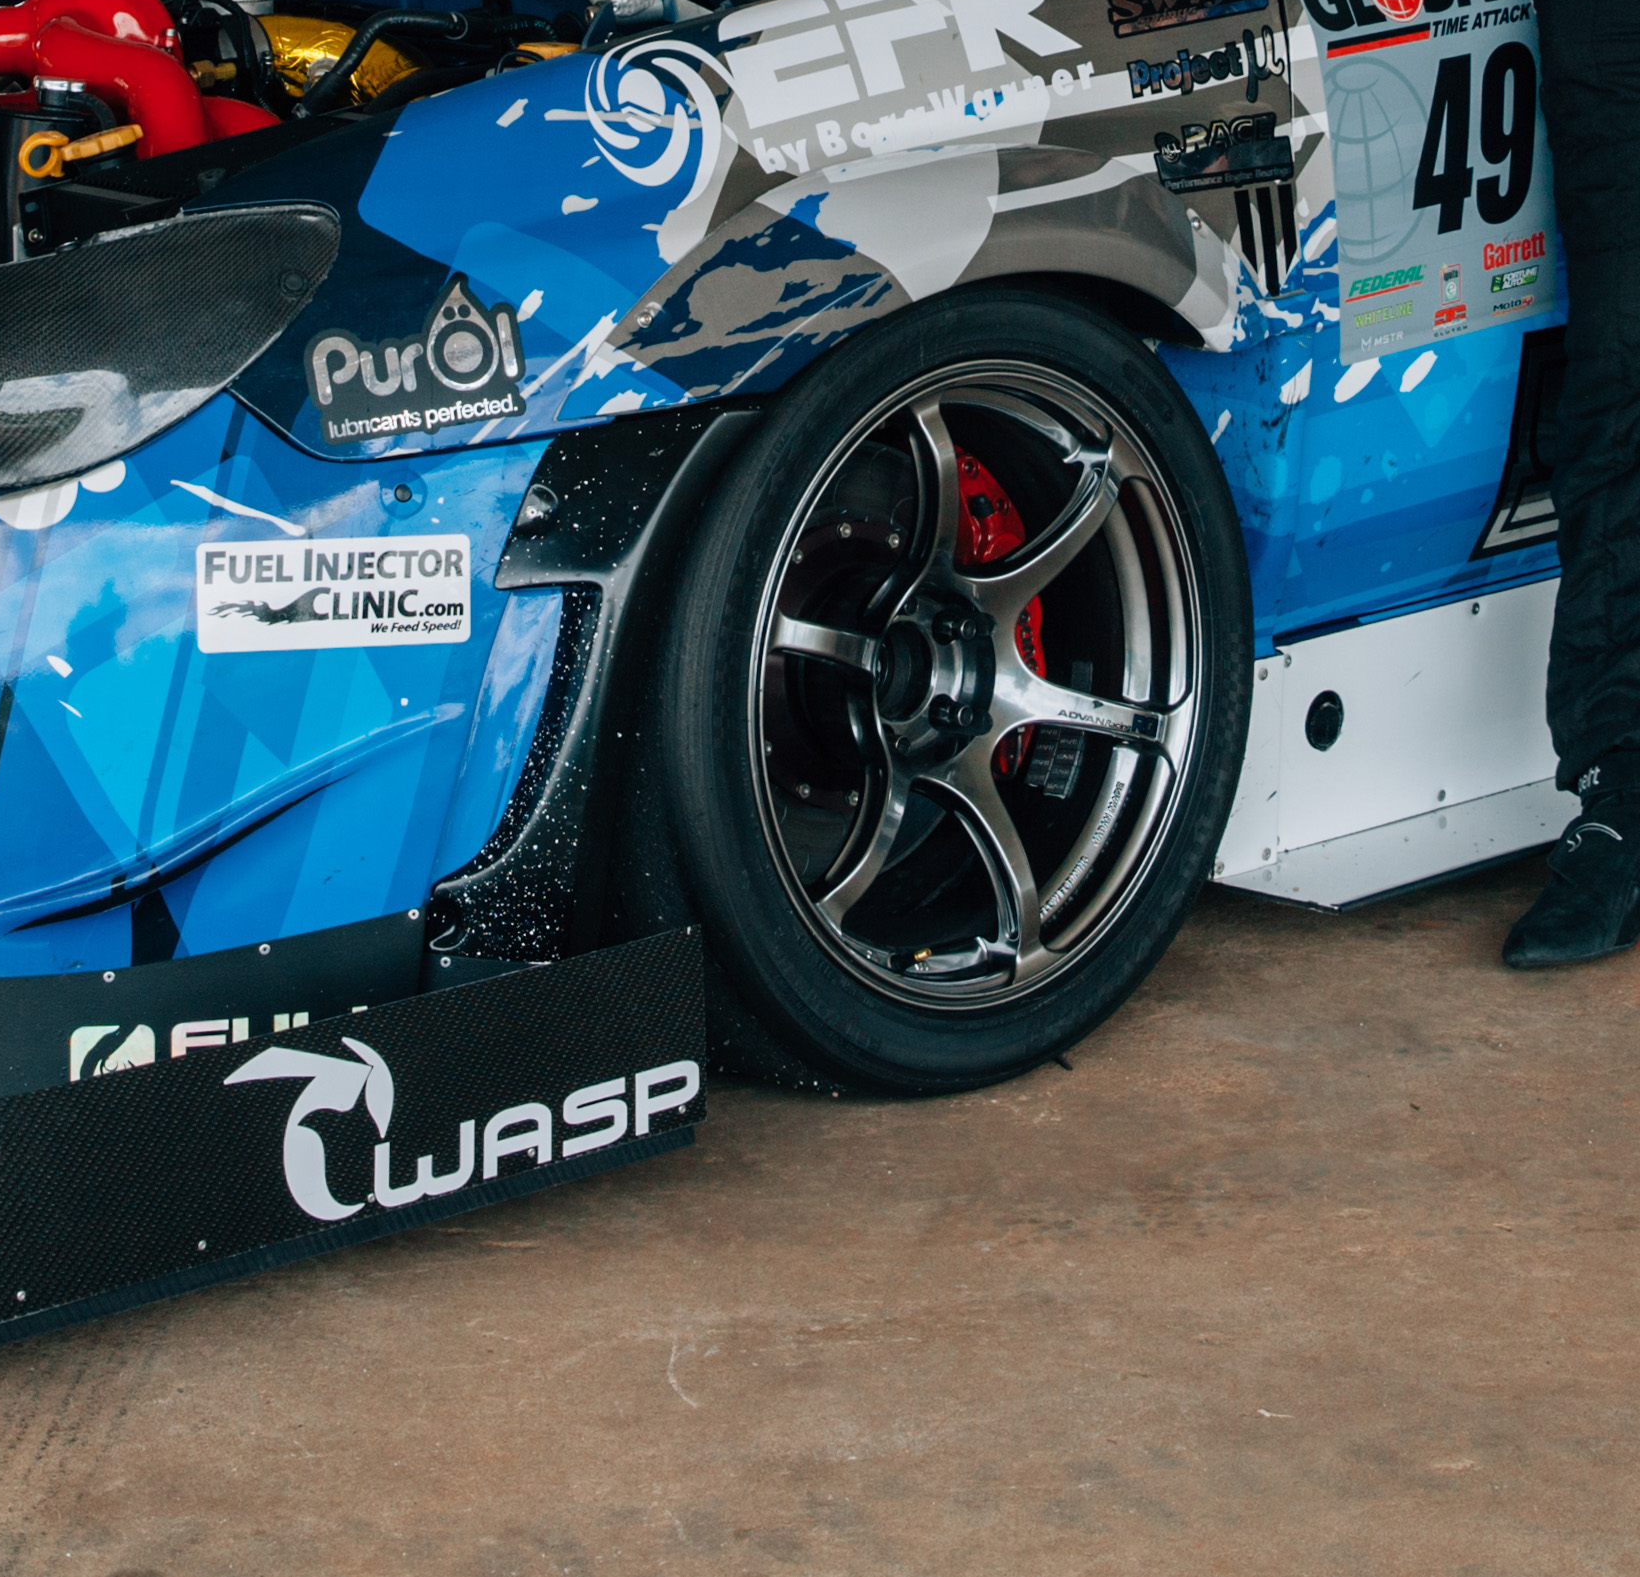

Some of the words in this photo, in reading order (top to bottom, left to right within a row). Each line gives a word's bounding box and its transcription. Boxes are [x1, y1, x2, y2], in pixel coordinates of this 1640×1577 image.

[1432, 15, 1470, 39] TIME
[1471, 2, 1532, 30] ATTACK
[1181, 111, 1277, 153] RACE
[1413, 42, 1537, 235] 49
[753, 134, 809, 176] by
[1483, 231, 1545, 270] Garrett
[1348, 264, 1425, 298] FEDERAL
[1501, 278, 1523, 290] AUTO
[1503, 266, 1538, 282] FORTUNE
[1354, 300, 1414, 328] WHITELINE
[1374, 330, 1404, 346] MSTR
[328, 409, 422, 439] lubricants
[426, 393, 519, 430] perfected.
[204, 551, 293, 585] FUEL
[303, 548, 464, 582] INJECTOR
[370, 622, 389, 634] We
[390, 621, 419, 633] Feed
[421, 620, 462, 634] Speed!
[1058, 709, 1105, 725] ADVAN
[373, 1059, 701, 1208] WASP
